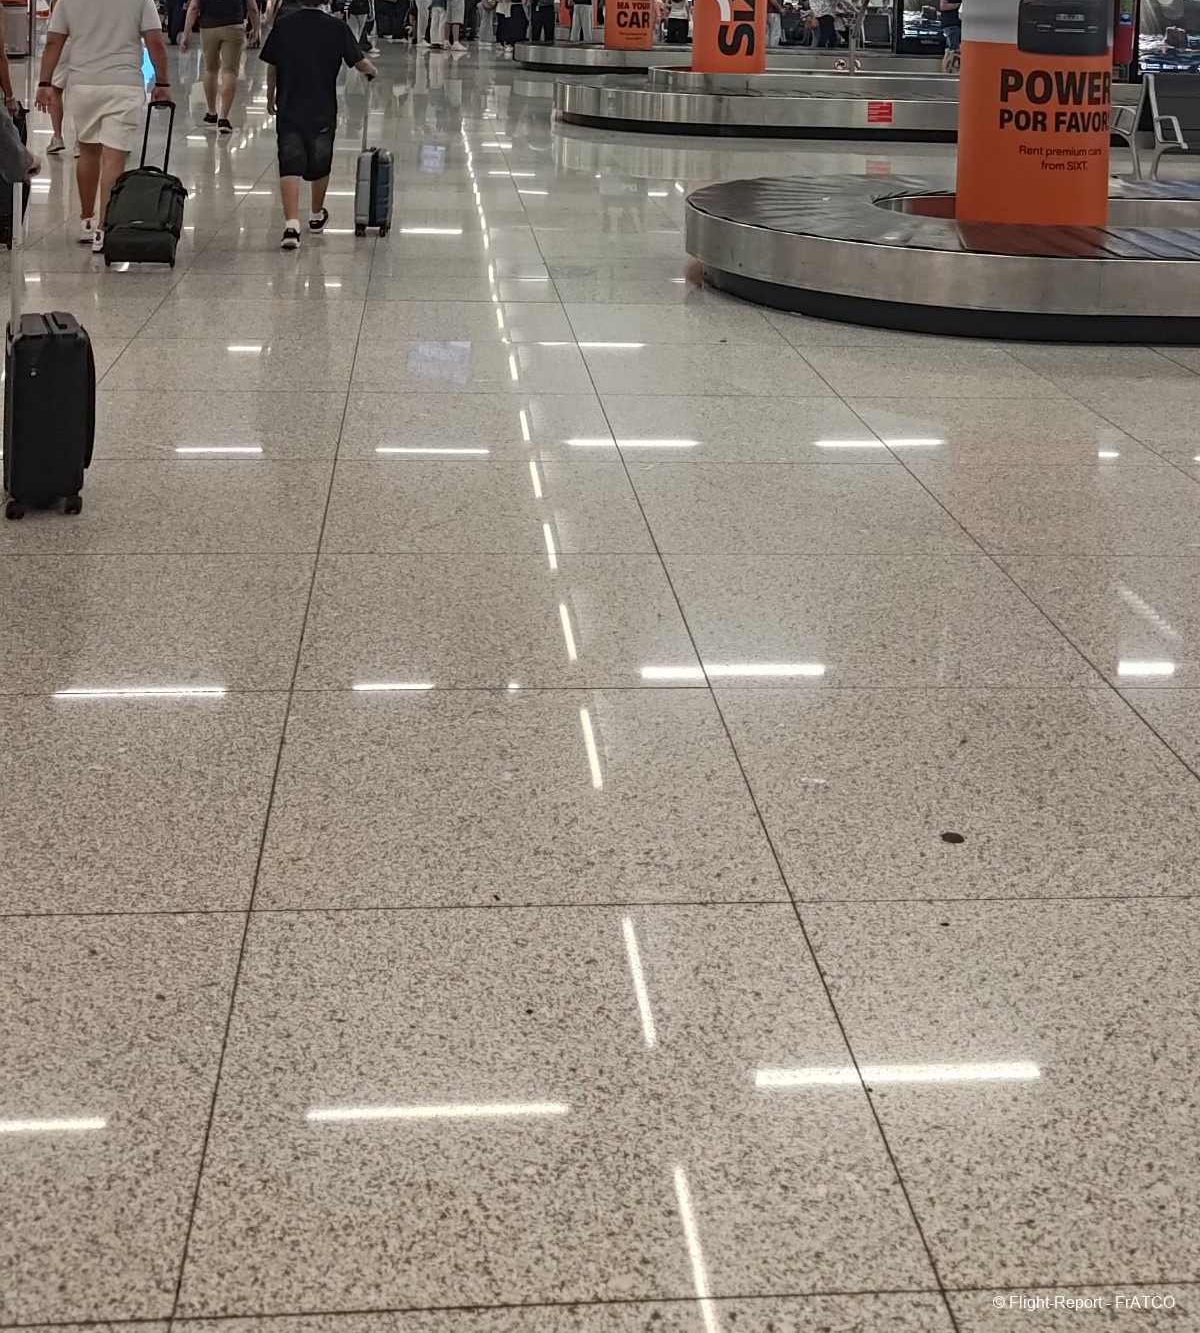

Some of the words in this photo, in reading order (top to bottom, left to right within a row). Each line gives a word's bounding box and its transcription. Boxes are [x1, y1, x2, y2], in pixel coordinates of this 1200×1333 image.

[617, 1, 630, 10] MA
[617, 10, 651, 29] CAR
[1000, 68, 1111, 106] POWER
[999, 108, 1047, 132] POR
[1019, 145, 1043, 155] Rent
[1045, 147, 1087, 157] premium
[1041, 160, 1065, 170] from
